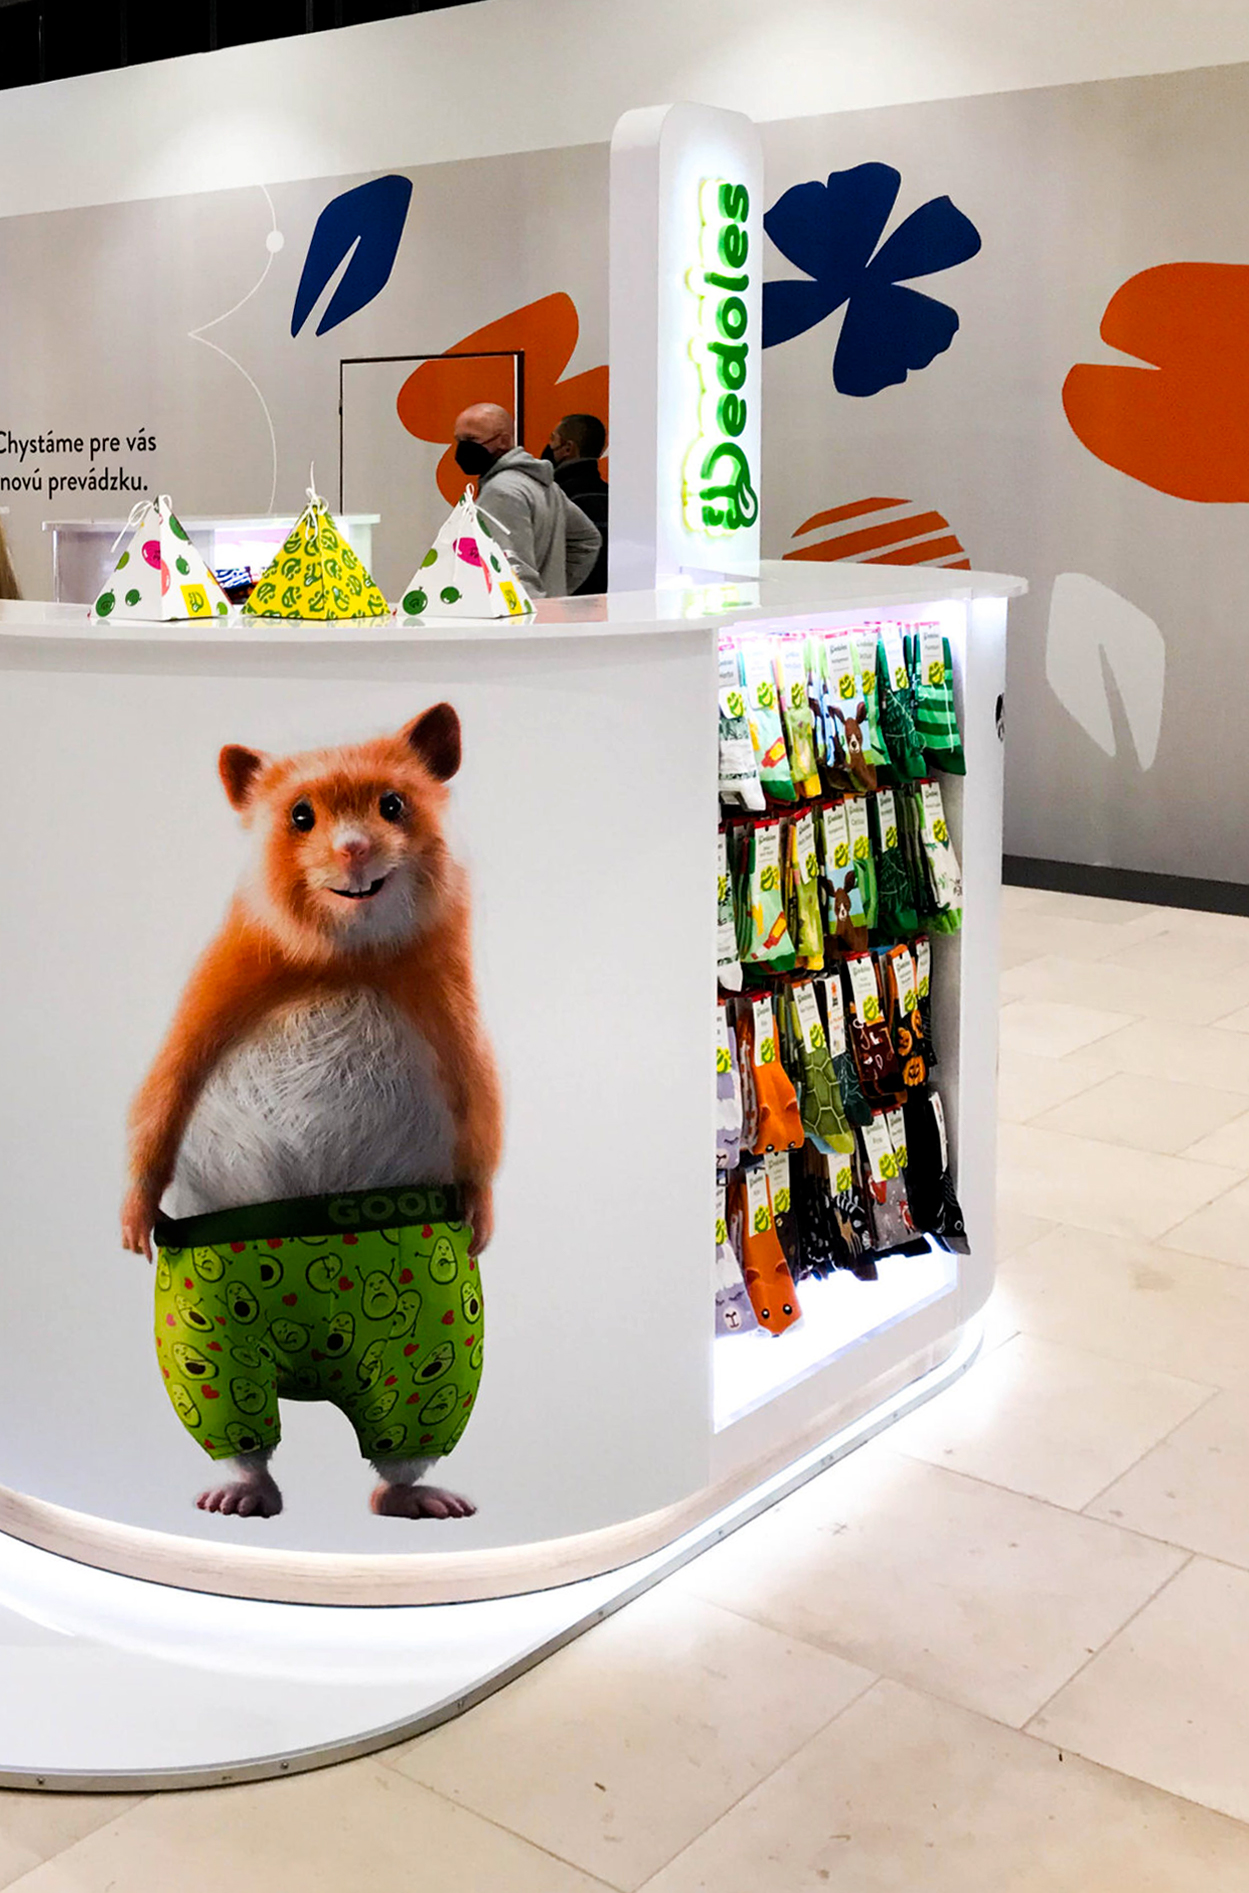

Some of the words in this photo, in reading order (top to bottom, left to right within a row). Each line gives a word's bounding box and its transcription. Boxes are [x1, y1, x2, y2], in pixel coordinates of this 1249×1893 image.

[699, 183, 758, 529] Dedoles
[90, 436, 120, 461] pre
[126, 427, 157, 451] vás
[1, 468, 42, 491] novú
[48, 467, 148, 499] prevádzku.
[328, 1190, 447, 1225] GOOD
